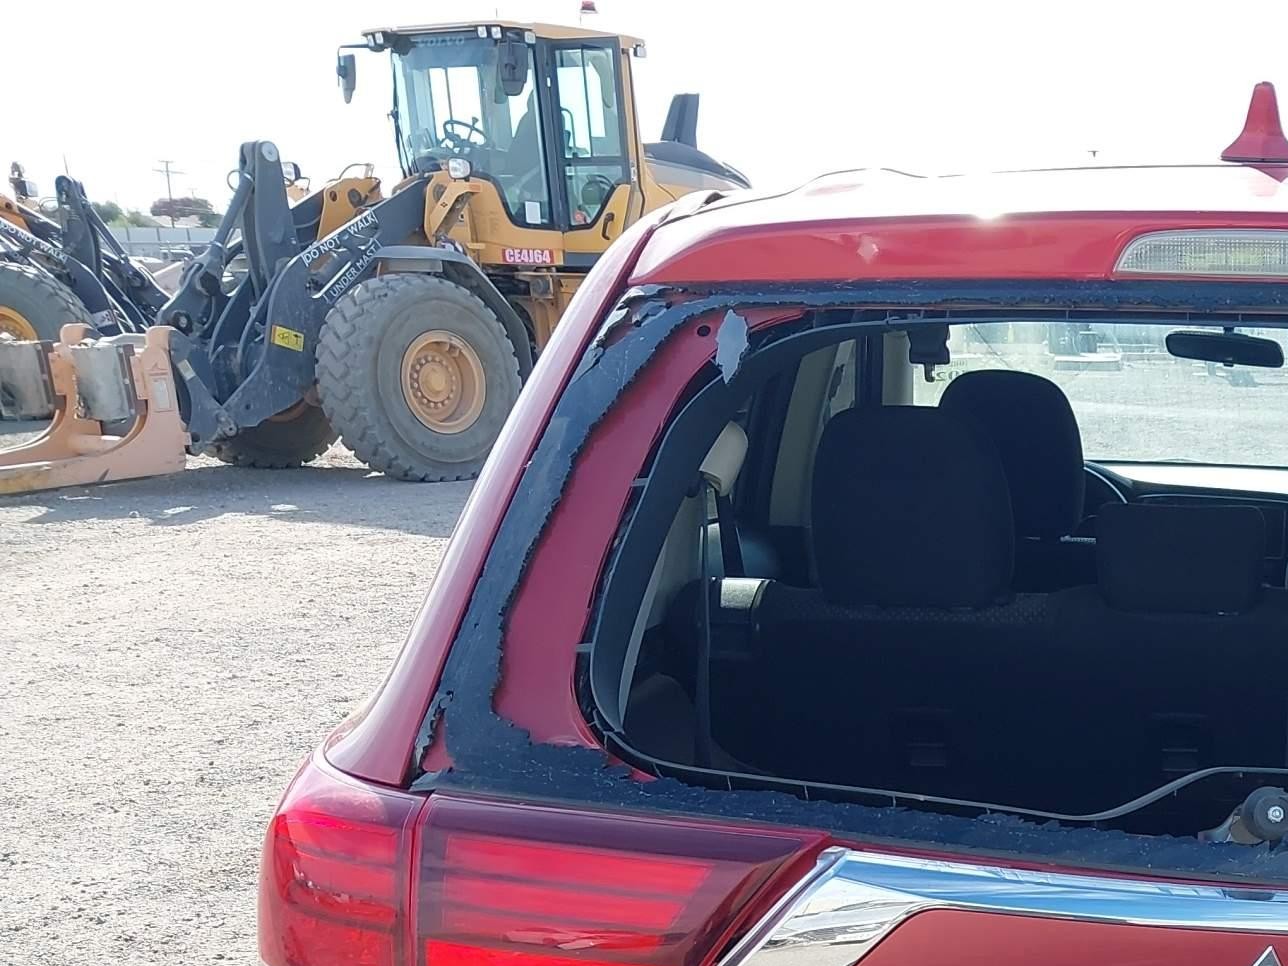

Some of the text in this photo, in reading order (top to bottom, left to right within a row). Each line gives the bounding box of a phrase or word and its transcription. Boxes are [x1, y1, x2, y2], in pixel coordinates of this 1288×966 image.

[304, 214, 376, 263] DO NOT WALK
[330, 244, 377, 296] UNDER MAST
